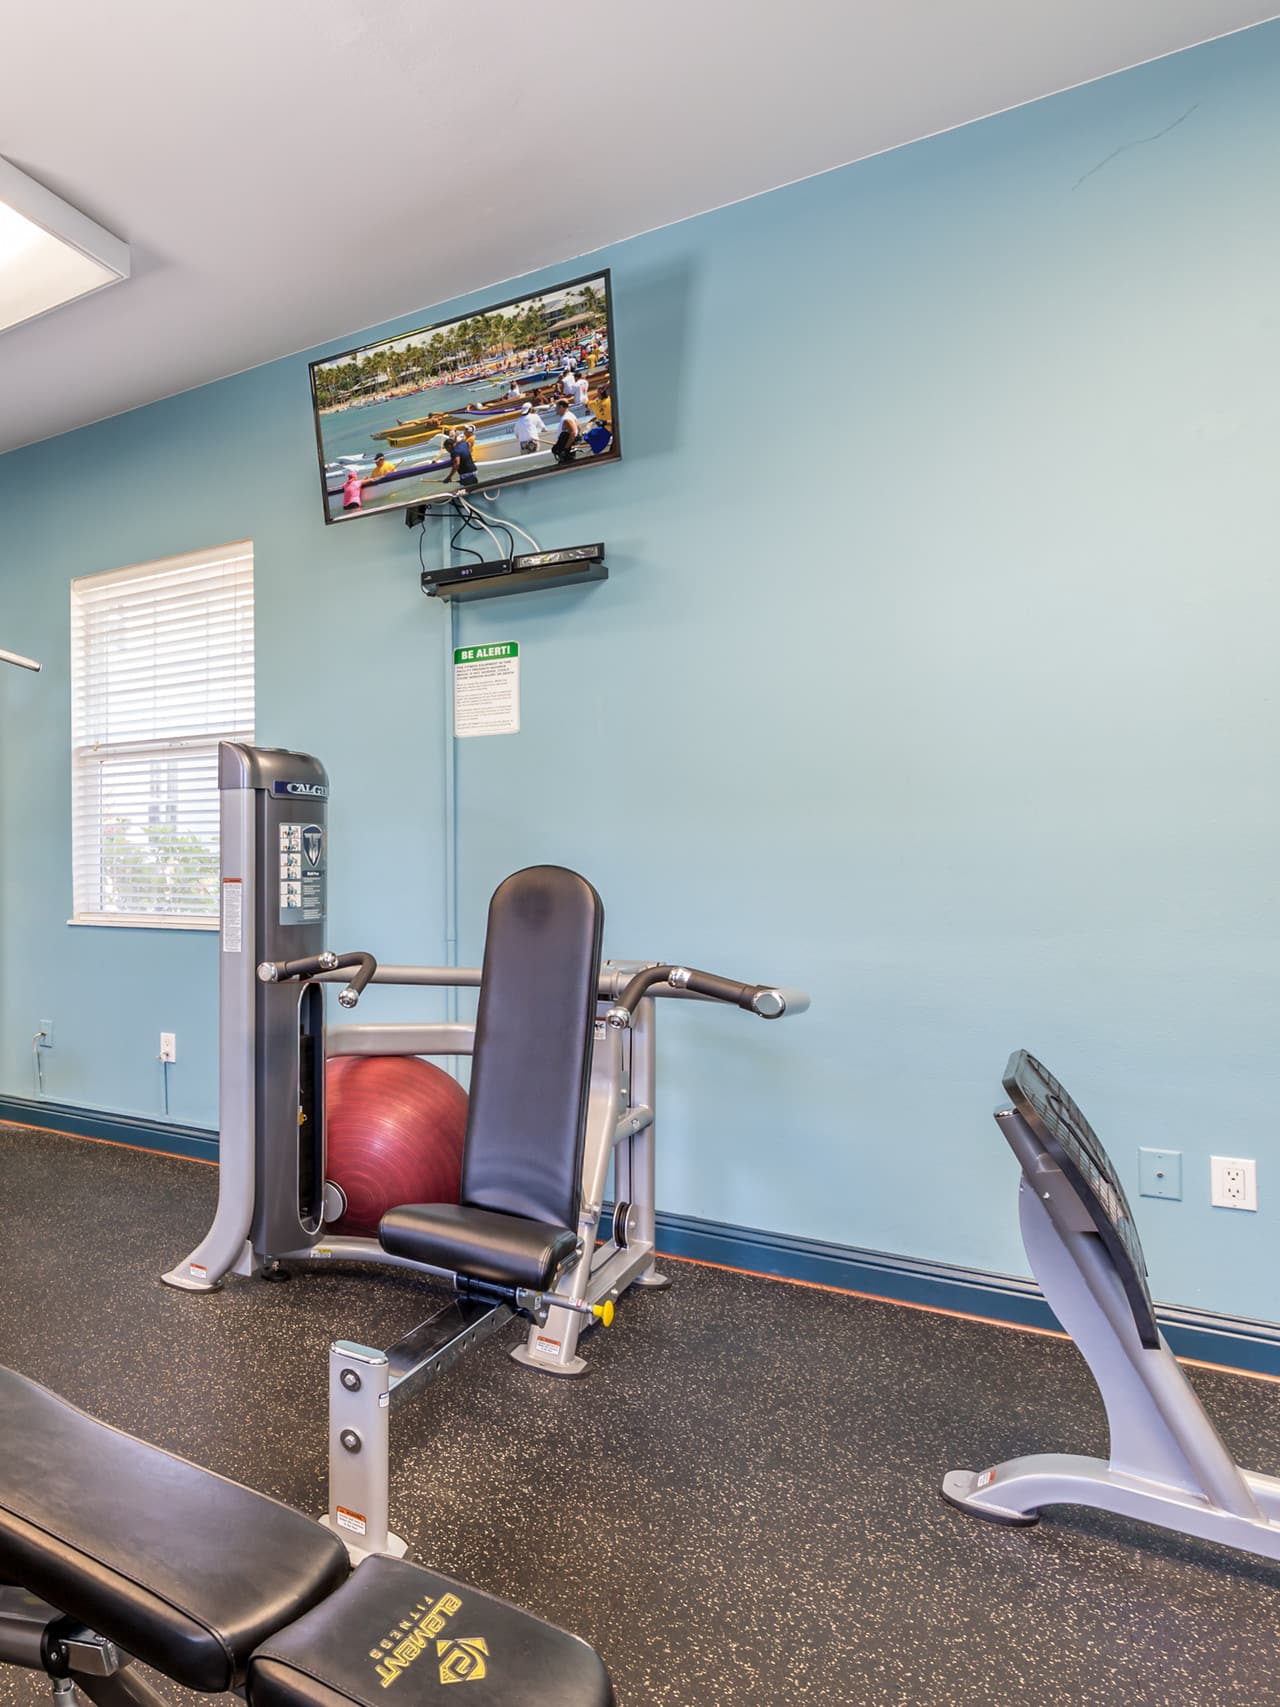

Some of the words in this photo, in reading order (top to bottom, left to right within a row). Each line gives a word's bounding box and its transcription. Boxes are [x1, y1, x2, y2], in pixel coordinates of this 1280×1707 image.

[461, 650, 474, 660] BE
[476, 645, 511, 658] ALERT!
[369, 1595, 434, 1660] FITNESS
